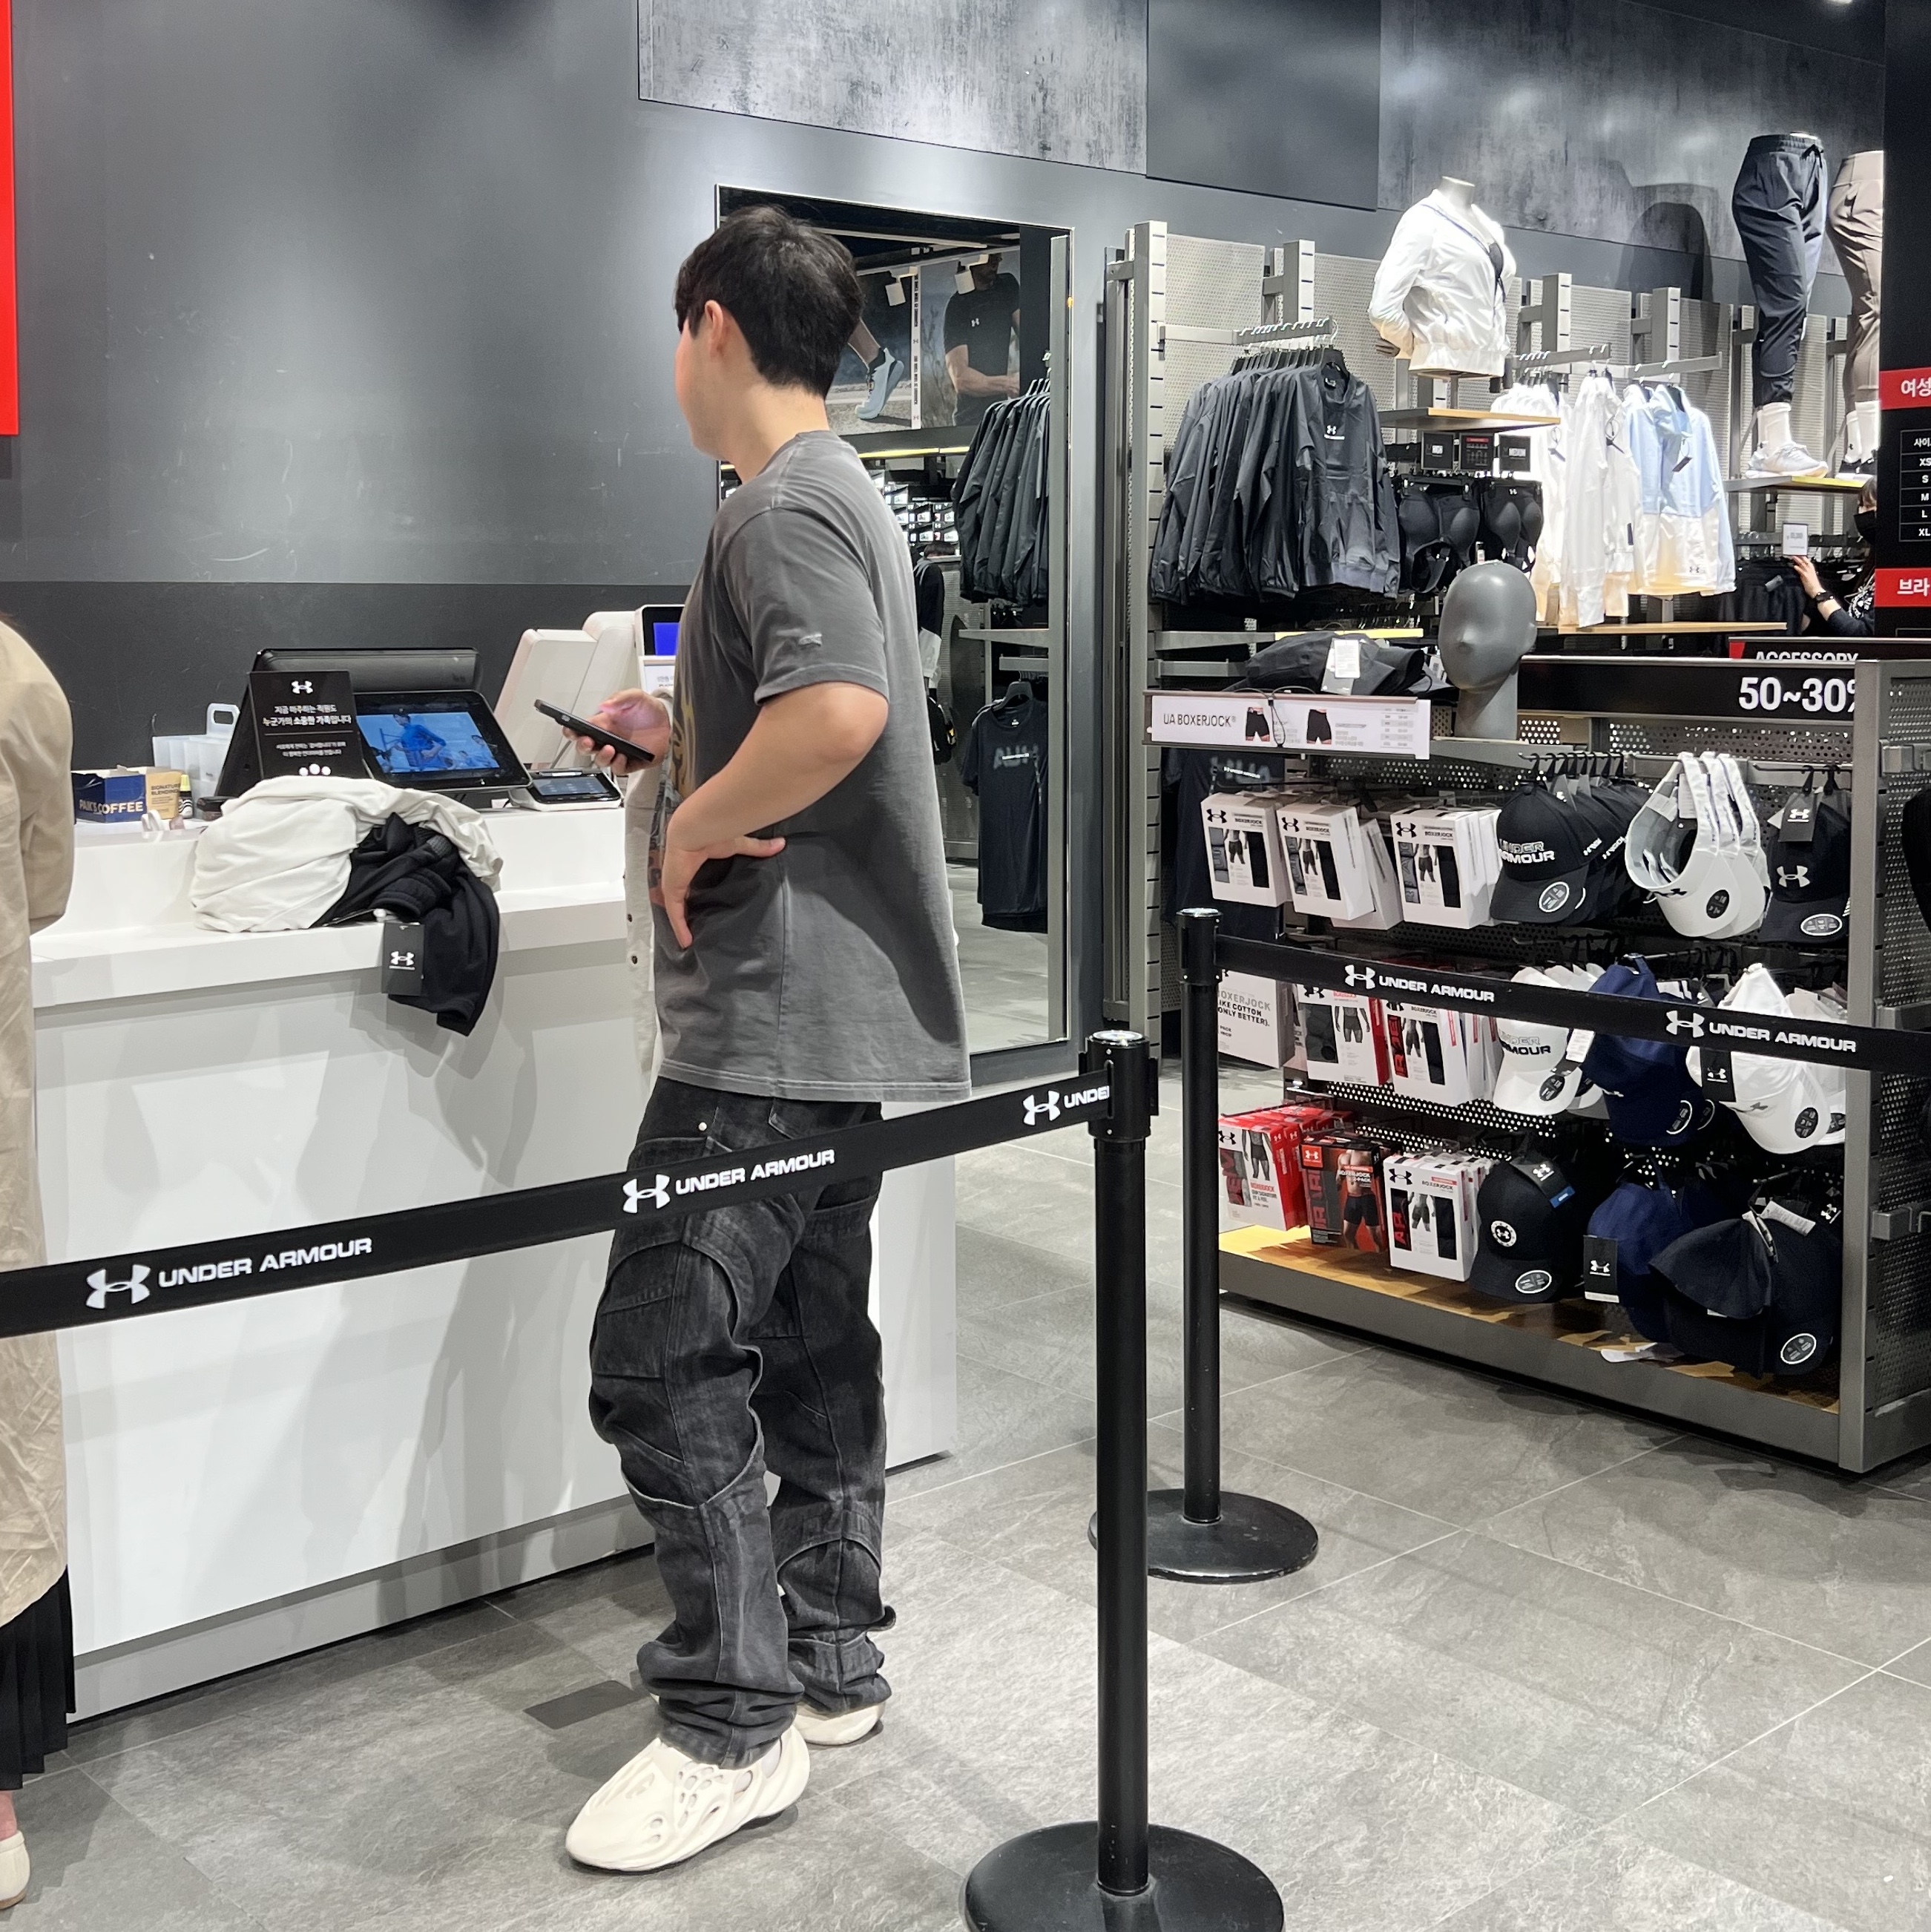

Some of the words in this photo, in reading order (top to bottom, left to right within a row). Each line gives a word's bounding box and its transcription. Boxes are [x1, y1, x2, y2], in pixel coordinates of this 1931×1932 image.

[1913, 438, 1931, 449] 사이
[1921, 475, 1930, 483] S
[1921, 493, 1930, 502] M
[1921, 510, 1928, 518] L
[1918, 528, 1930, 536] XL
[1896, 577, 1930, 597] 브라
[1163, 713, 1176, 724] UA
[97, 801, 145, 815] COFFEE
[1378, 975, 1428, 993] UNDER
[1430, 984, 1495, 1002] ARMOUR
[1232, 1003, 1262, 1016] COTTON
[1708, 1022, 1771, 1041] UNDER
[1774, 1032, 1857, 1053] ARMOUR
[1063, 1085, 1110, 1108] UNDE
[676, 1166, 746, 1195] UNDER
[750, 1149, 835, 1180] ARMOUR
[158, 1257, 252, 1288] UNDER
[260, 1237, 372, 1272] ARMOUR
